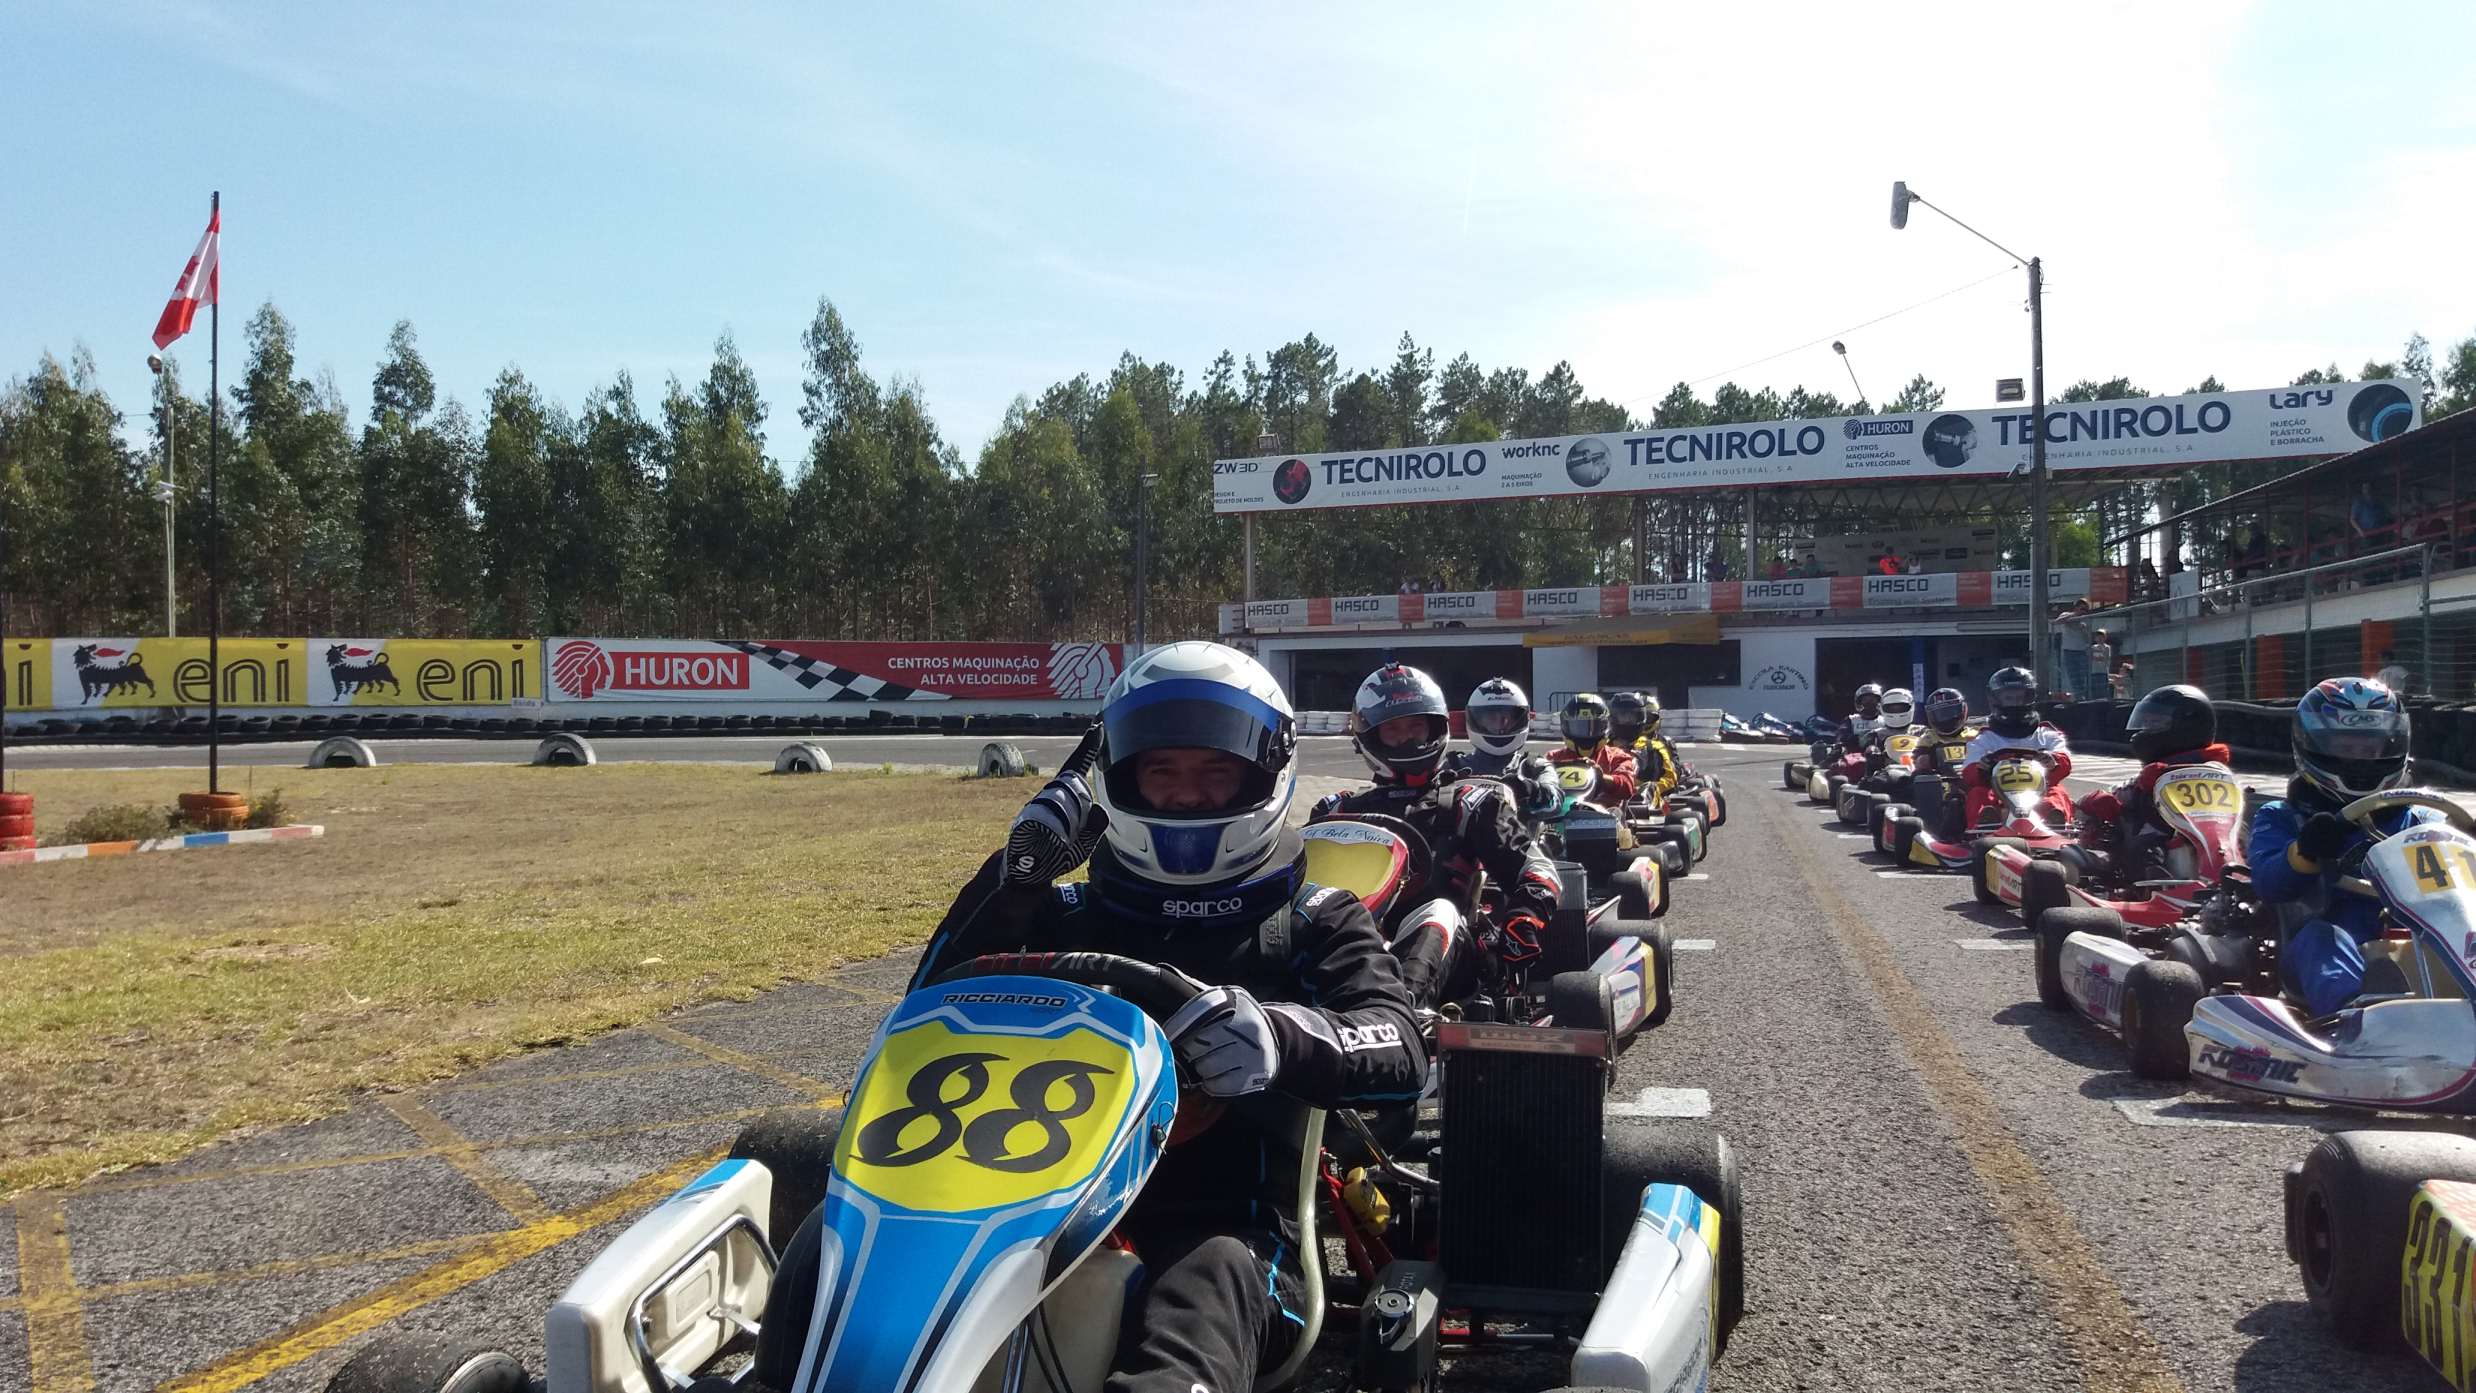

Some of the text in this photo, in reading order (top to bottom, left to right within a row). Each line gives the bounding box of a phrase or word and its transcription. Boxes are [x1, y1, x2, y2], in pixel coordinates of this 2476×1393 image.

[1868, 422, 1910, 434] HURON
[1992, 401, 2231, 446] TECNIROLO
[1623, 426, 1825, 466] TECNIROLO
[1321, 448, 1487, 485] TECNIROLO
[1865, 459, 1912, 467] VELOCIDADE
[1648, 470, 1709, 480] ENGENHARIA
[1340, 488, 1391, 498] ENGENHARIA
[1867, 578, 1929, 593] HASCO
[1996, 573, 2060, 589] HASO
[1633, 588, 1688, 602] HASCO
[1747, 583, 1805, 598] HASCO
[1335, 599, 1380, 613] HASCO
[1428, 596, 1476, 609] HASCO
[1527, 592, 1578, 606] HASCO
[1247, 602, 1290, 617] HASCO
[887, 655, 1040, 672] CENTROS MAQUINAÇÃO
[173, 643, 290, 703] eni
[416, 644, 524, 702] eni
[625, 657, 739, 686] HURON
[921, 673, 1038, 686] ALTA VELOCIDADE
[1999, 764, 2033, 785] 25
[2177, 782, 2233, 808] 302
[1162, 896, 1242, 918] sparco
[942, 993, 1067, 1007] RICCIARDO
[849, 1052, 1116, 1174] 88
